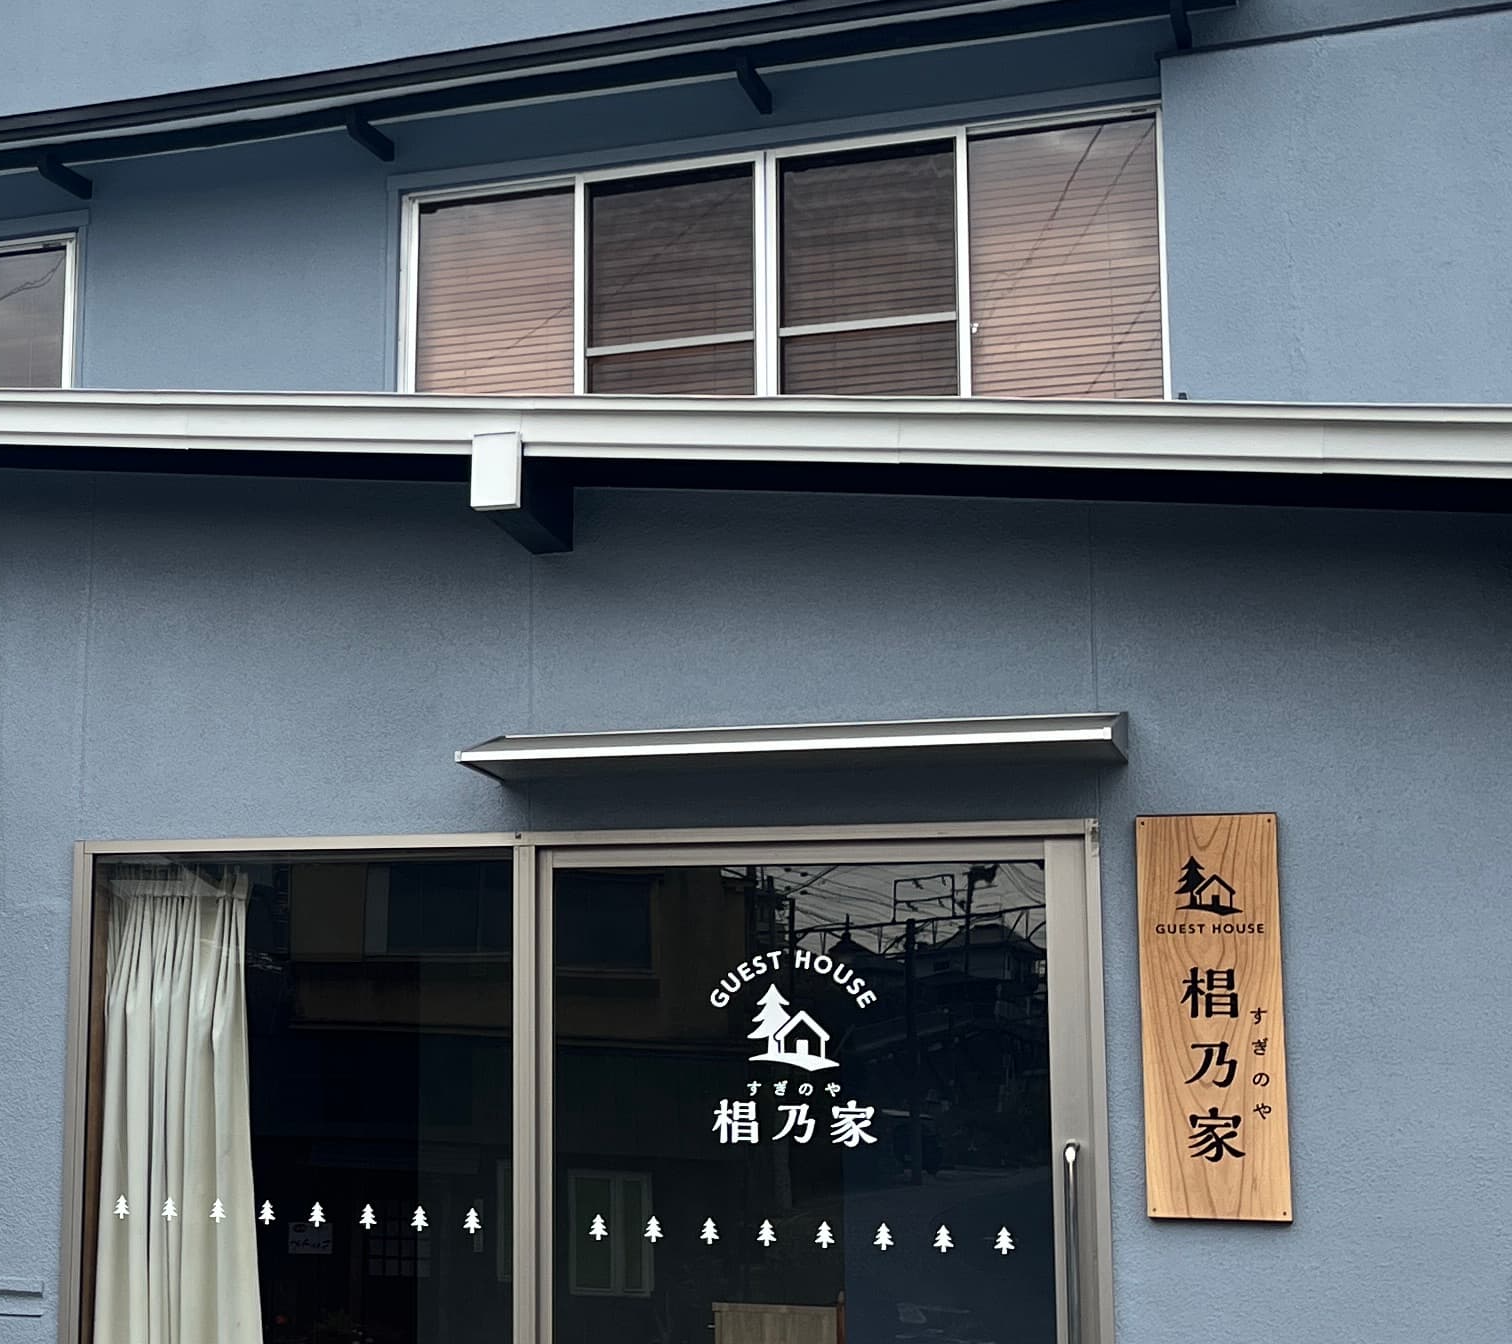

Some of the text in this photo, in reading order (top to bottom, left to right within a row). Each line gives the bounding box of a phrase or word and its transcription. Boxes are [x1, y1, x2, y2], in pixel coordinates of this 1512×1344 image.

[1155, 922, 1265, 935] GUEST HOUSE
[710, 949, 877, 1009] GUEST HOUSE
[746, 1080, 841, 1098] すぎのや
[1180, 966, 1246, 1163] 椙乃家
[1249, 1007, 1272, 1120] すぎのや
[711, 1098, 878, 1148] 椙乃家
